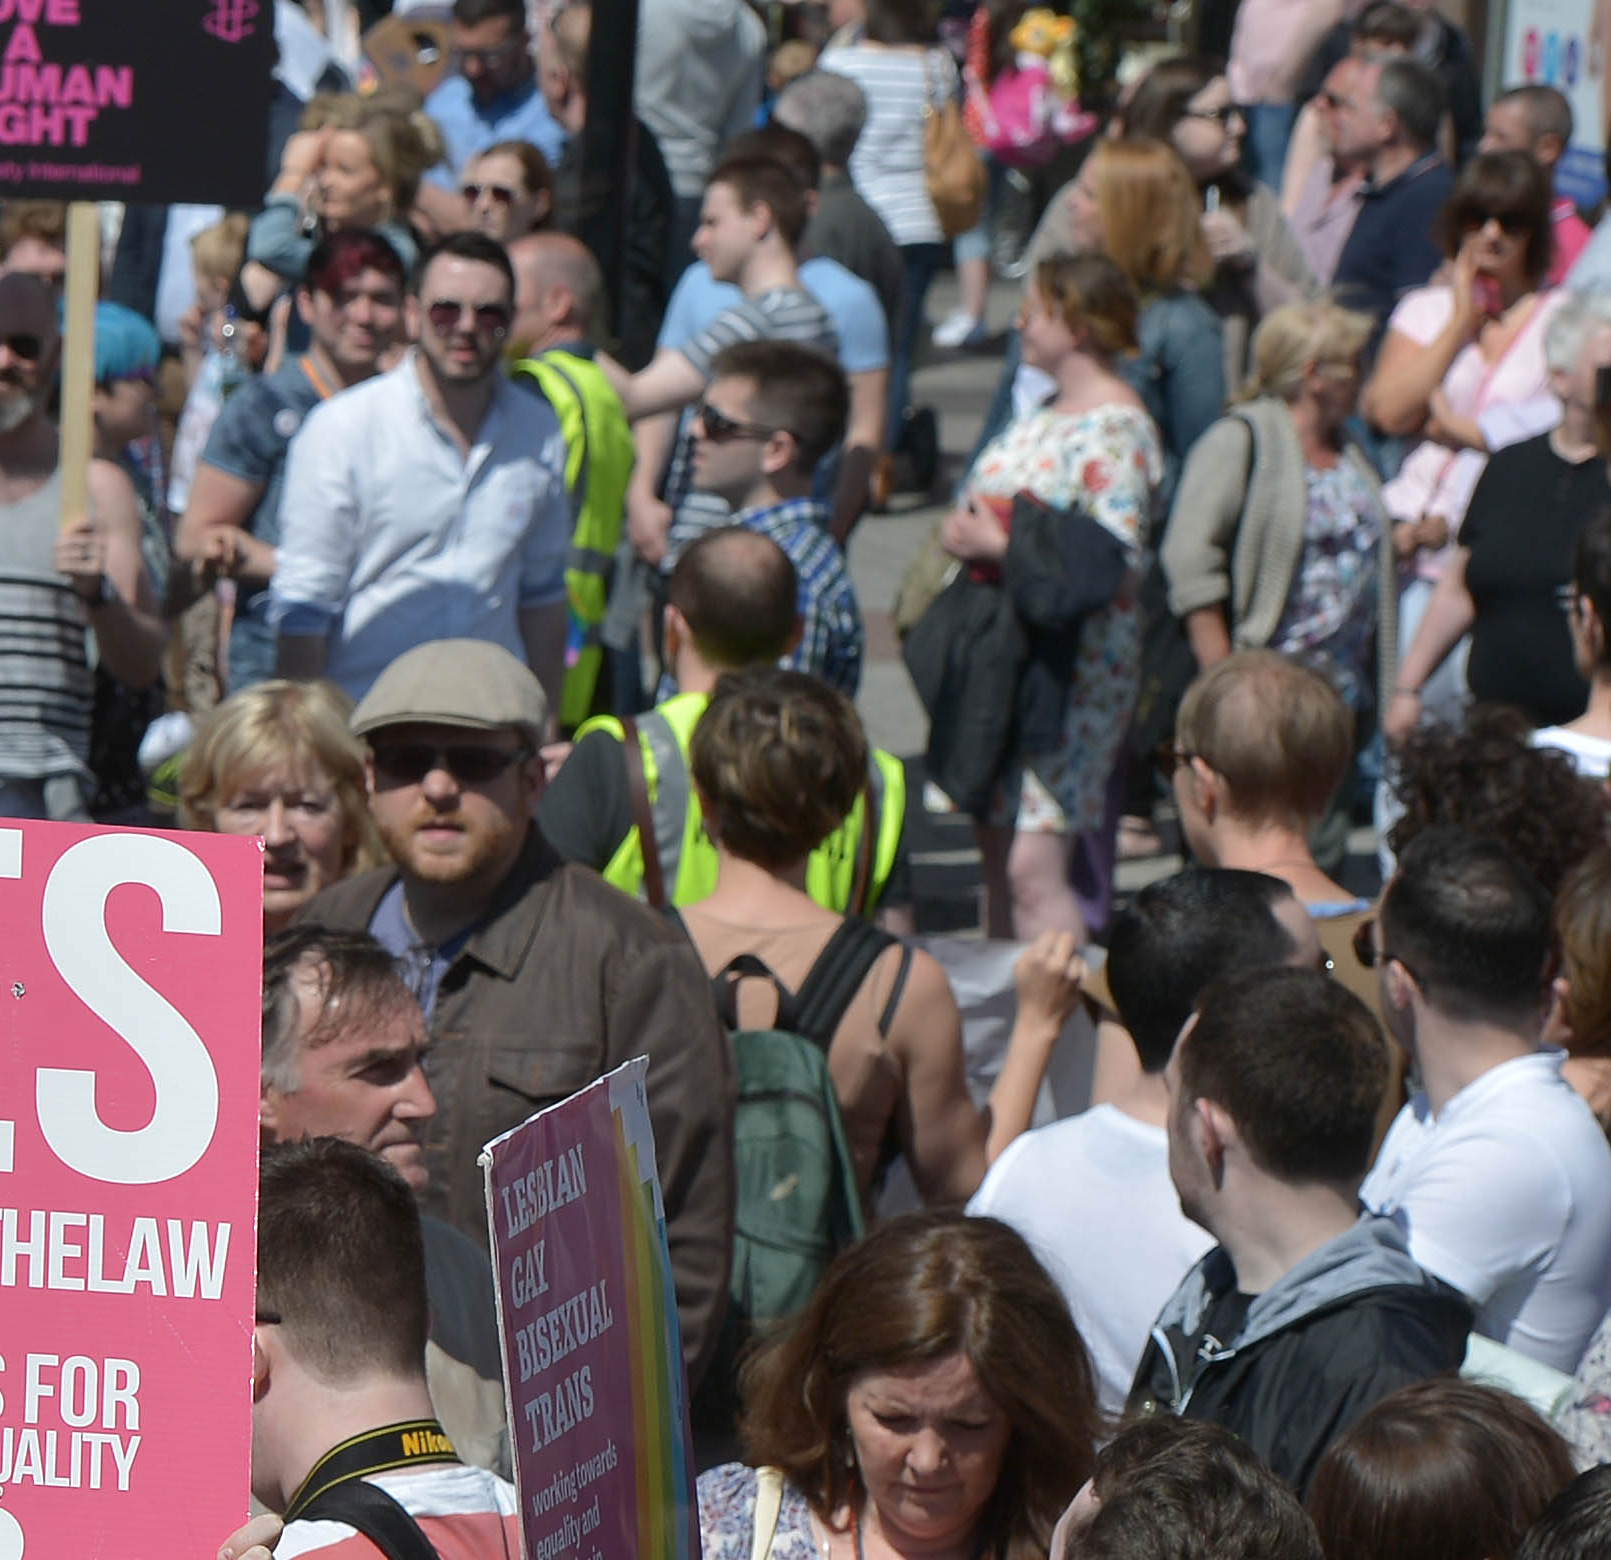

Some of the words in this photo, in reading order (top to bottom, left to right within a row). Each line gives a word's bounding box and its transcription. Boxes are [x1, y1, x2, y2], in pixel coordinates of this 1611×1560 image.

[3, 23, 41, 61] A
[501, 1143, 587, 1240] LESBIAN
[511, 1239, 550, 1310] GAY
[515, 1278, 614, 1385] BISEXUAL
[23, 1352, 142, 1432] FOR
[524, 1364, 595, 1453] TRANS
[532, 1469, 577, 1518] working
[575, 1437, 619, 1490] towards
[581, 1494, 601, 1536] and
